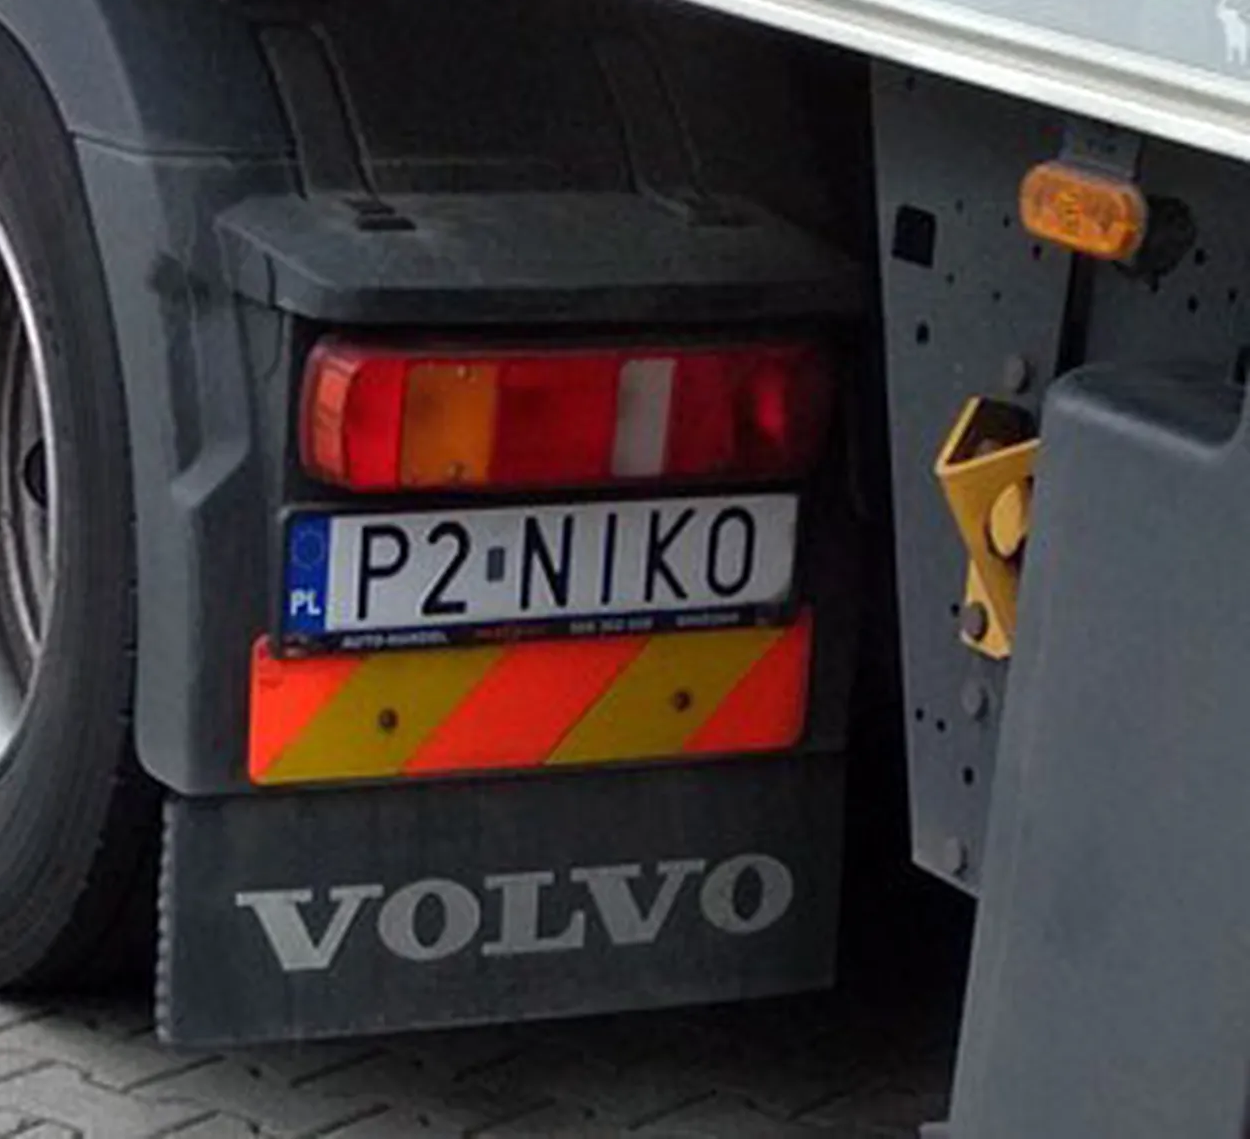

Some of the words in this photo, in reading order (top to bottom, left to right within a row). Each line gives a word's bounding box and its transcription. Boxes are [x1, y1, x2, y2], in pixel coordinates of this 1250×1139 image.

[289, 589, 322, 617] PL
[356, 521, 472, 622] P2
[519, 506, 757, 611] NIKO
[235, 853, 794, 972] VOLVO
